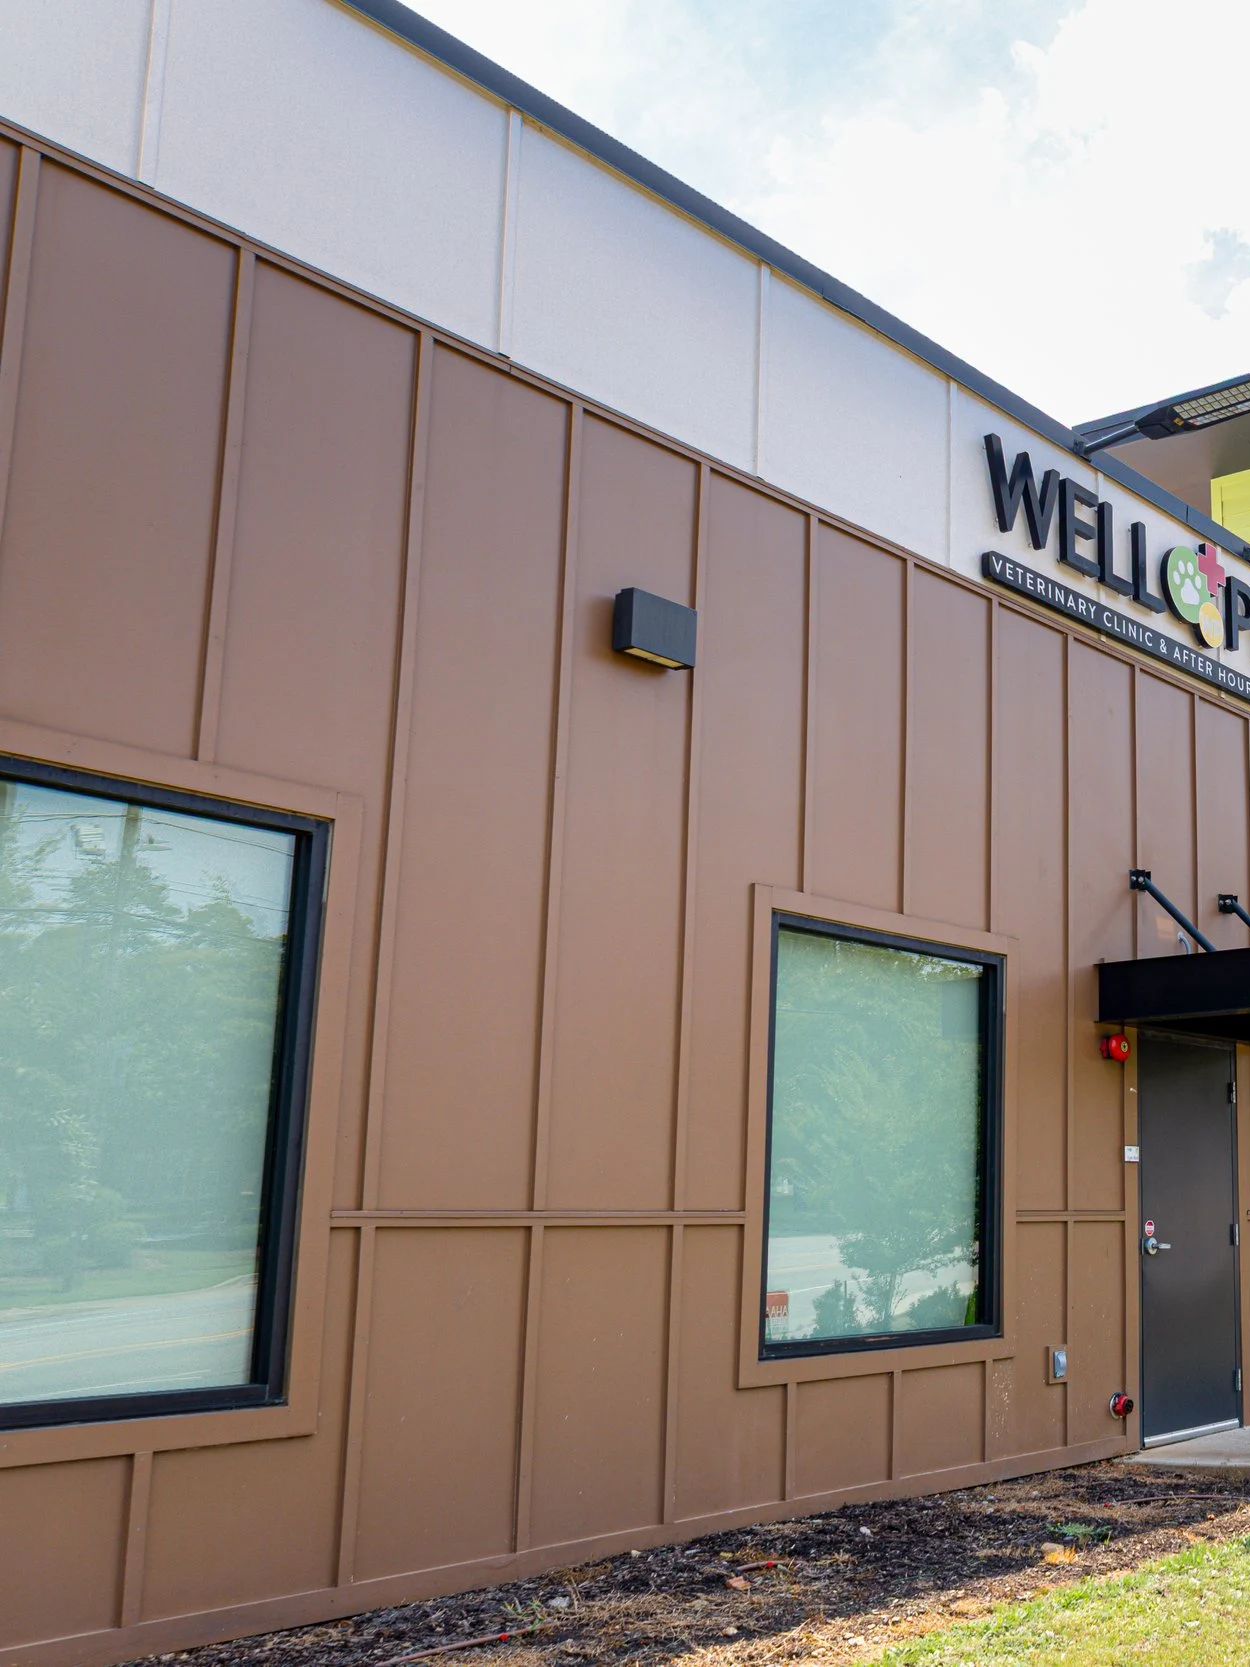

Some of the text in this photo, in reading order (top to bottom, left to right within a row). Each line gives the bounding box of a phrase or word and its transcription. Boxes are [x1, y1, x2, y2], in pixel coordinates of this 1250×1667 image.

[984, 432, 1166, 614] WELL
[992, 555, 1097, 620] VETERINARY
[1103, 611, 1153, 647] CLINIC
[1159, 638, 1168, 654] &
[1173, 646, 1213, 677] AFTER
